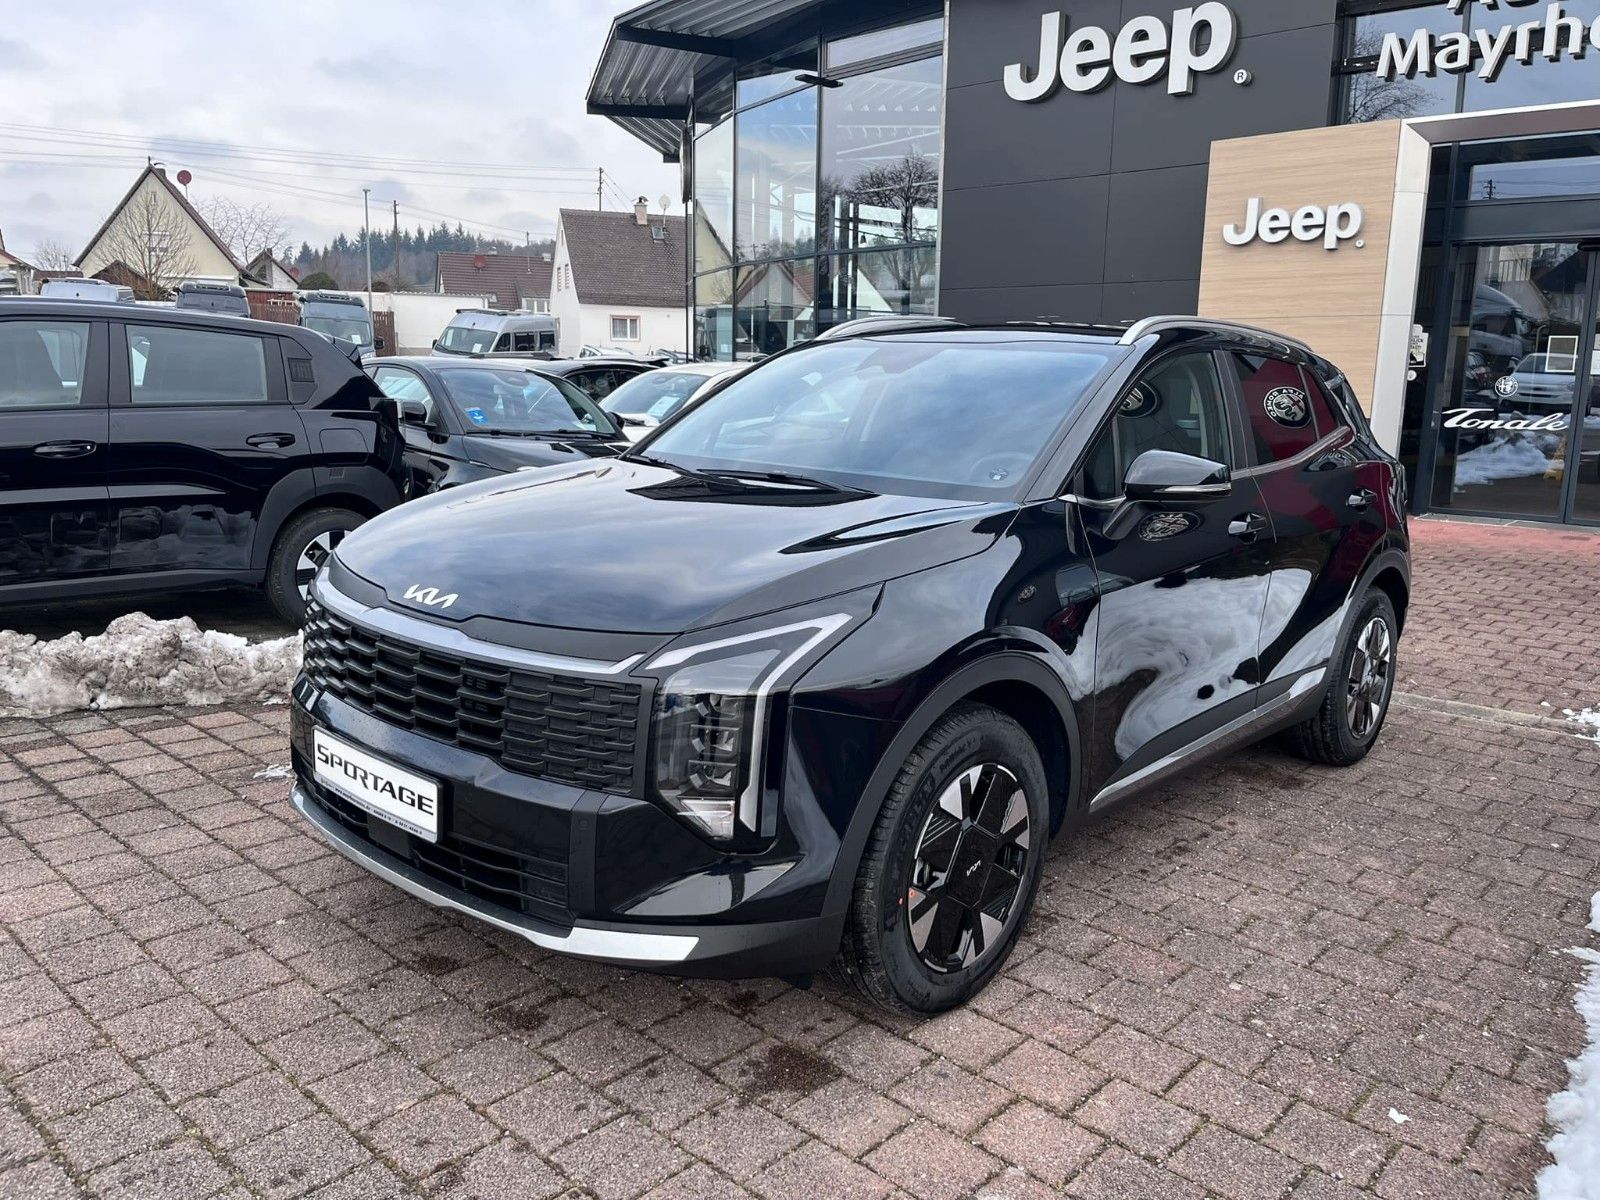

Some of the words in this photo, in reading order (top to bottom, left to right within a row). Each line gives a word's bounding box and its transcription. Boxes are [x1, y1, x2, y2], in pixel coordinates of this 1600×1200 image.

[1003, 1, 1237, 102] Jeep
[1222, 197, 1362, 250] Jeep
[1441, 407, 1569, 431] Tonale
[402, 583, 459, 609] KIA
[317, 743, 435, 816] SPORTAGE
